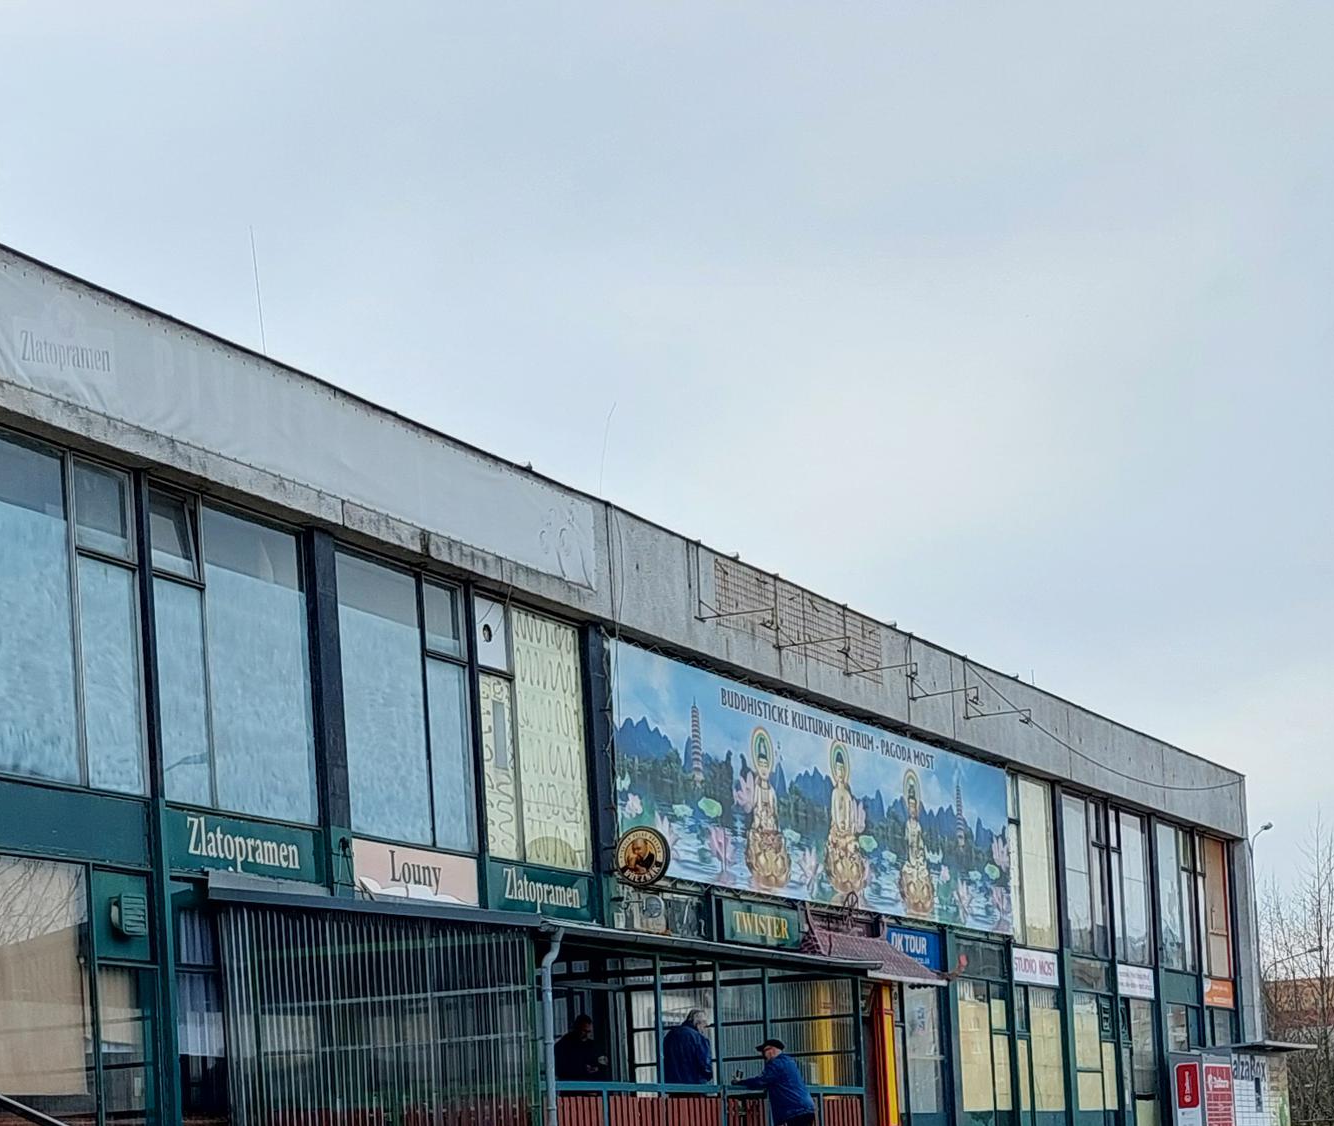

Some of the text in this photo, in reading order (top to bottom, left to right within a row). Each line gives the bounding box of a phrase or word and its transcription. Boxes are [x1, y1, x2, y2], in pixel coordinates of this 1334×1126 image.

[20, 329, 110, 372] Zlatopramen
[721, 688, 789, 726] BUDDHISTICKÉ
[792, 710, 833, 739] KULTURNÍ
[835, 726, 874, 752] CENTRUM
[880, 739, 912, 764] PAGODA
[913, 751, 935, 770] MOST
[187, 816, 300, 873] Zlatopramen
[389, 850, 442, 896] Louny
[503, 866, 581, 914] Zlatopramen
[733, 911, 789, 939] TWISTER
[904, 934, 927, 956] TOUR
[1014, 957, 1055, 977] STUDIO MOST
